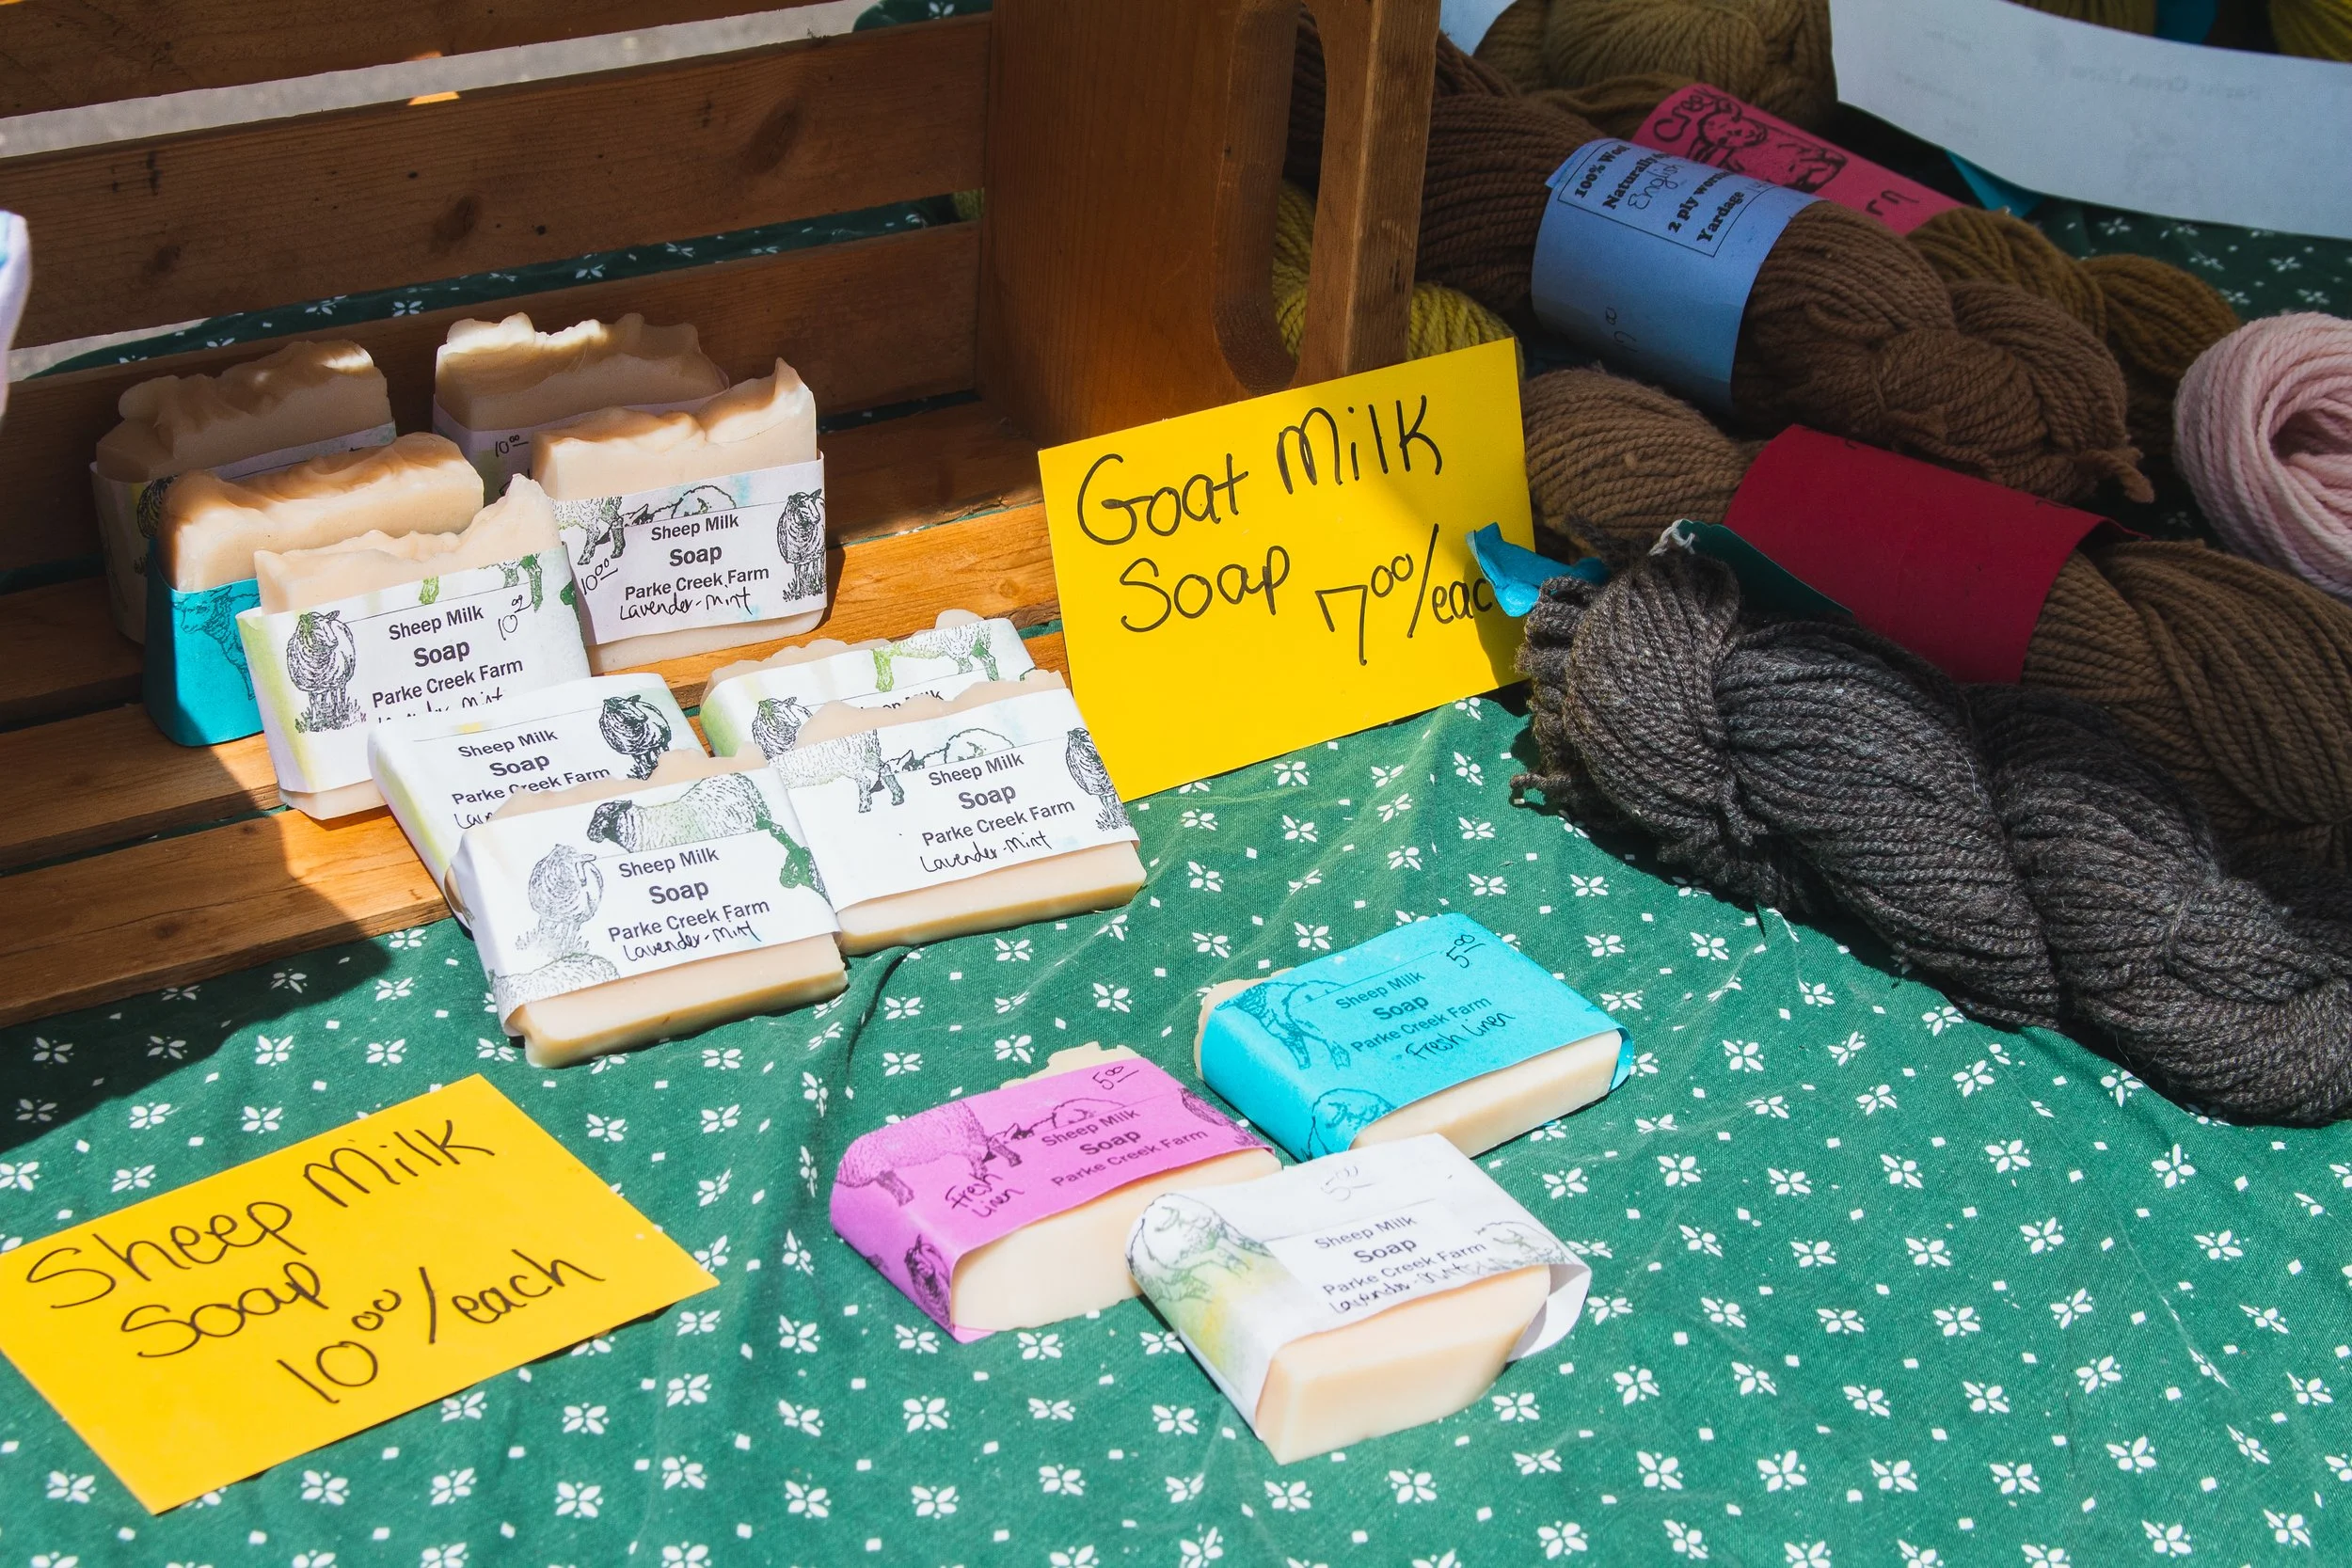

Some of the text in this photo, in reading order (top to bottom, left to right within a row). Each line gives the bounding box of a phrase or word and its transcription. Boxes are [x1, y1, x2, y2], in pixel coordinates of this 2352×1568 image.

[1574, 163, 1607, 198] 100%
[1666, 220, 1681, 234] 2
[1677, 193, 1701, 222] ply
[1695, 189, 1745, 243] Yardage
[1076, 452, 1249, 546] Goat
[651, 514, 739, 542] Sheep Milk
[669, 545, 723, 567] Soap
[625, 566, 770, 601] Parke Creek Farm
[1119, 545, 1291, 634] Soap
[389, 605, 485, 641] Sheep Milk
[413, 640, 471, 669] Soap
[372, 659, 524, 708] Parke Creek Farm
[457, 729, 559, 758] Sheep Milk
[488, 754, 551, 777] Soap
[928, 752, 1025, 786] Sheep Milk
[452, 786, 505, 805] Parke
[564, 768, 611, 784] Farm
[958, 784, 1017, 810] Soap
[921, 798, 1076, 847] Parke Creek Farm
[618, 847, 720, 878] Sheep Milk
[648, 879, 709, 905] Soap
[608, 900, 771, 942] Parke Creek Farm
[1335, 972, 1427, 1009] Sheep Milk
[1372, 994, 1429, 1021] Soap
[1350, 996, 1493, 1053] Parke Creek Farm
[1041, 1109, 1141, 1148] Sheep Milk
[1079, 1130, 1142, 1155] Soap
[1051, 1130, 1209, 1188] Parke Creek Farm
[1313, 1215, 1418, 1250] Sheep Milk
[1353, 1237, 1419, 1264] Soap
[25, 1199, 308, 1310] Sheep
[1322, 1241, 1487, 1296] Parke Creek Farm
[119, 1261, 329, 1360] Soap
